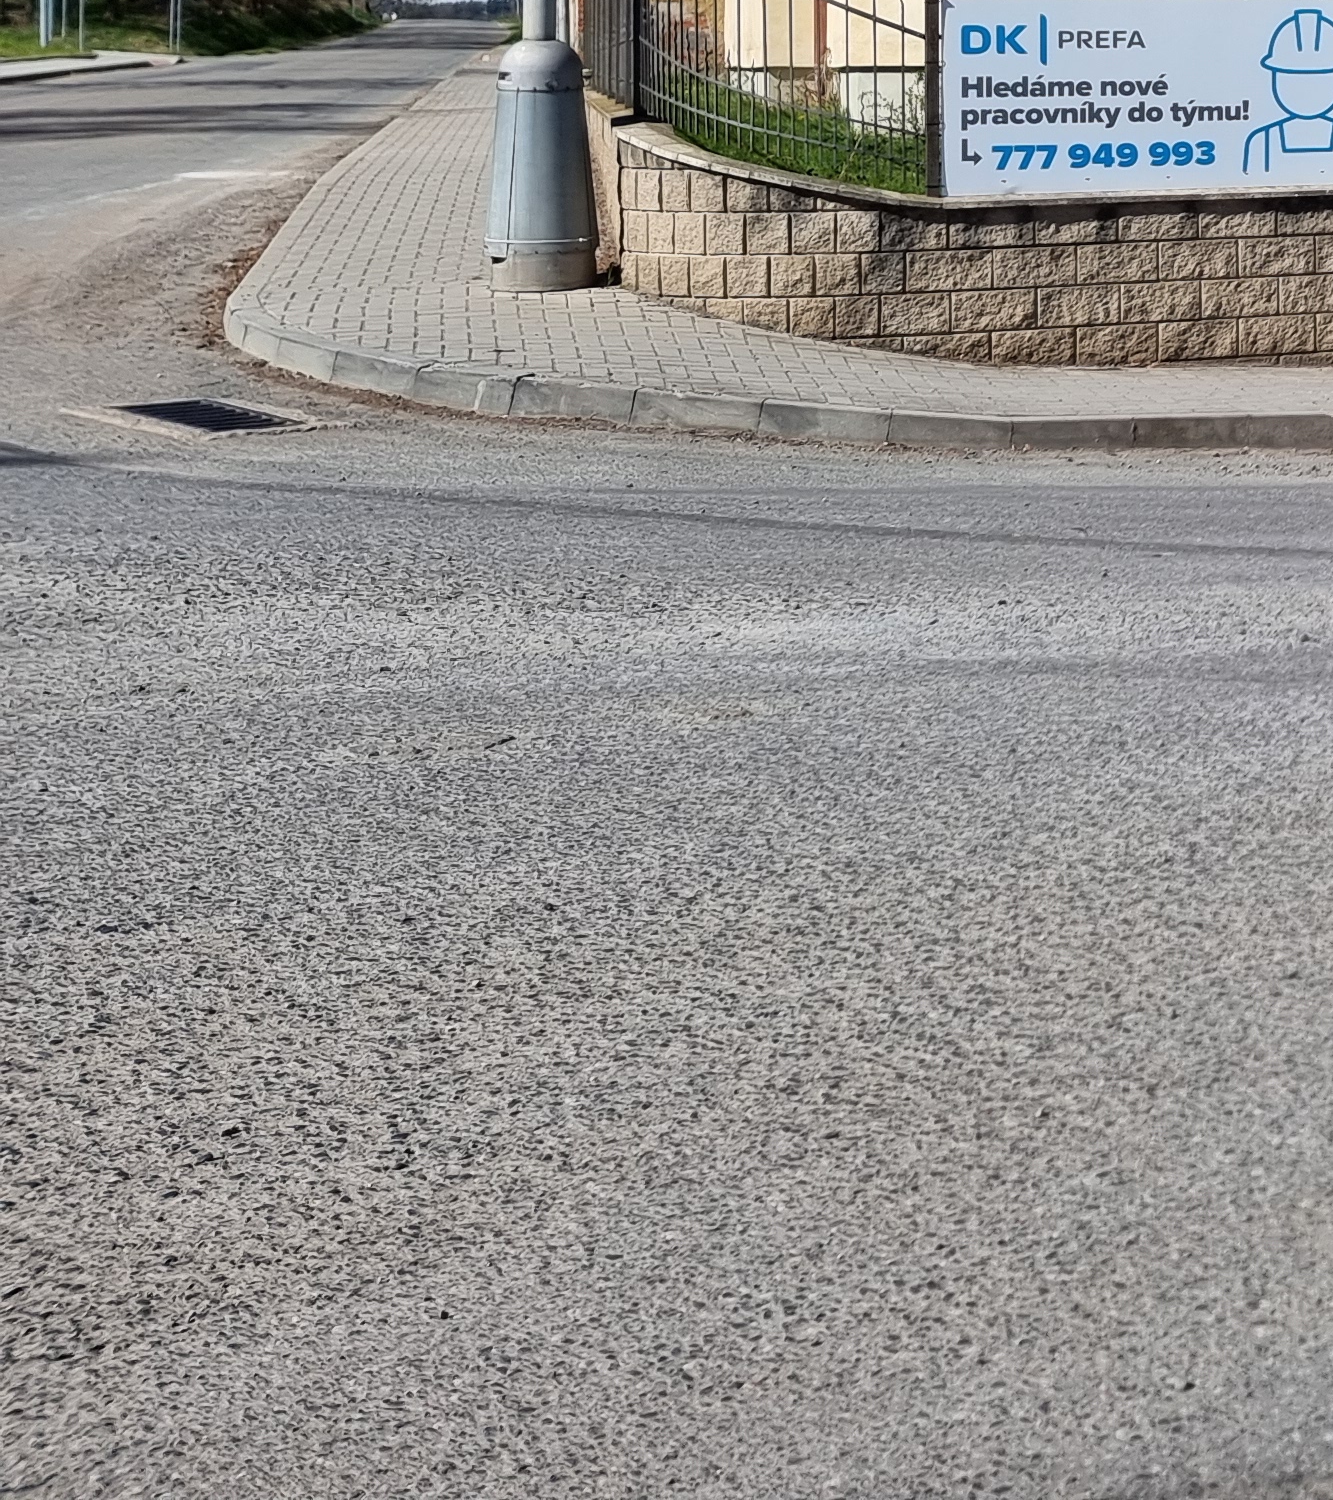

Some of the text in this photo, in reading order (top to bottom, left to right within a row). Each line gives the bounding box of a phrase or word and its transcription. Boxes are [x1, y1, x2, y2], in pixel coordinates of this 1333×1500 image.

[960, 24, 1146, 55] DK PREFA
[961, 73, 1168, 98] Hledáme nové
[961, 100, 1250, 131] pracovníky do týmu!
[992, 141, 1216, 170] 777 949 993
